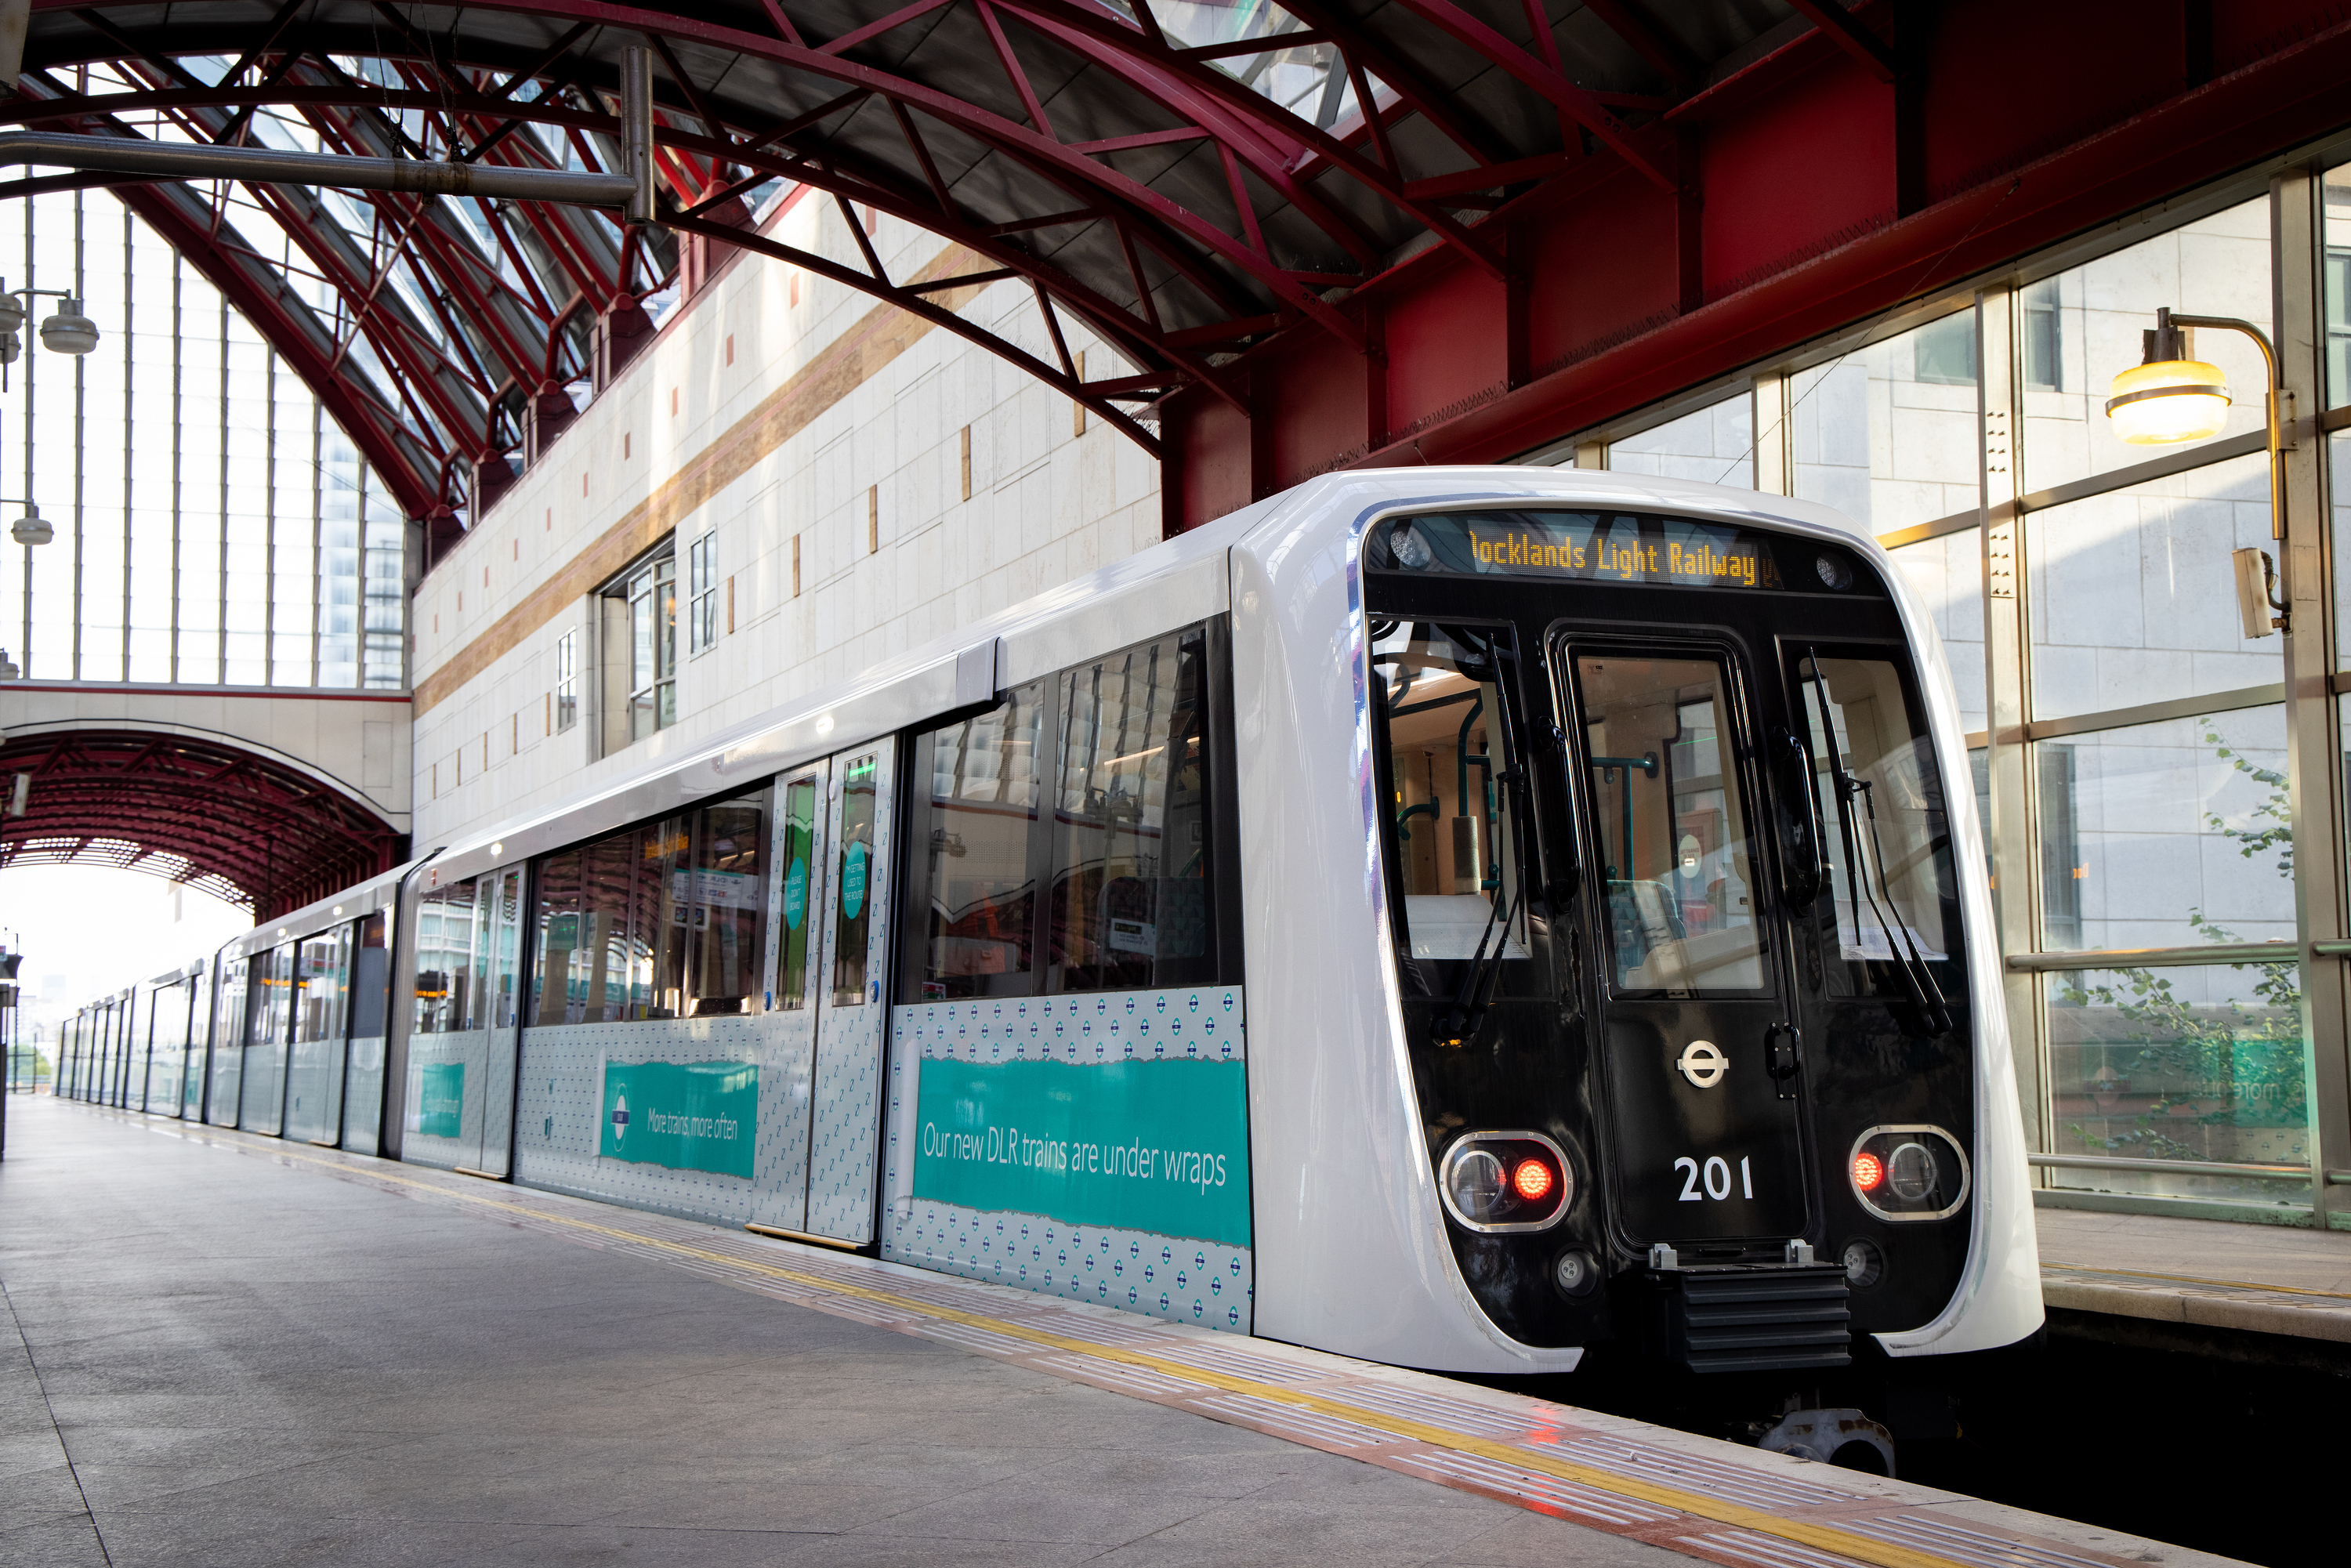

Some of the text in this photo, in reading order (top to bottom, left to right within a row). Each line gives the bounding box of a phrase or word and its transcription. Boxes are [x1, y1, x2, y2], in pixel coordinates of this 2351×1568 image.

[1597, 538, 1658, 579] Light
[1670, 542, 1756, 586] Railway
[791, 875, 802, 885] PLEASE
[647, 1107, 737, 1140] More trains, more often
[923, 1121, 952, 1158] Our
[953, 1132, 984, 1161] new
[987, 1126, 1018, 1165] DLR
[1022, 1132, 1067, 1170] trains
[1071, 1142, 1098, 1174] are
[1103, 1136, 1159, 1179] under
[1165, 1149, 1226, 1196] wraps
[1674, 1155, 1753, 1201] 201
